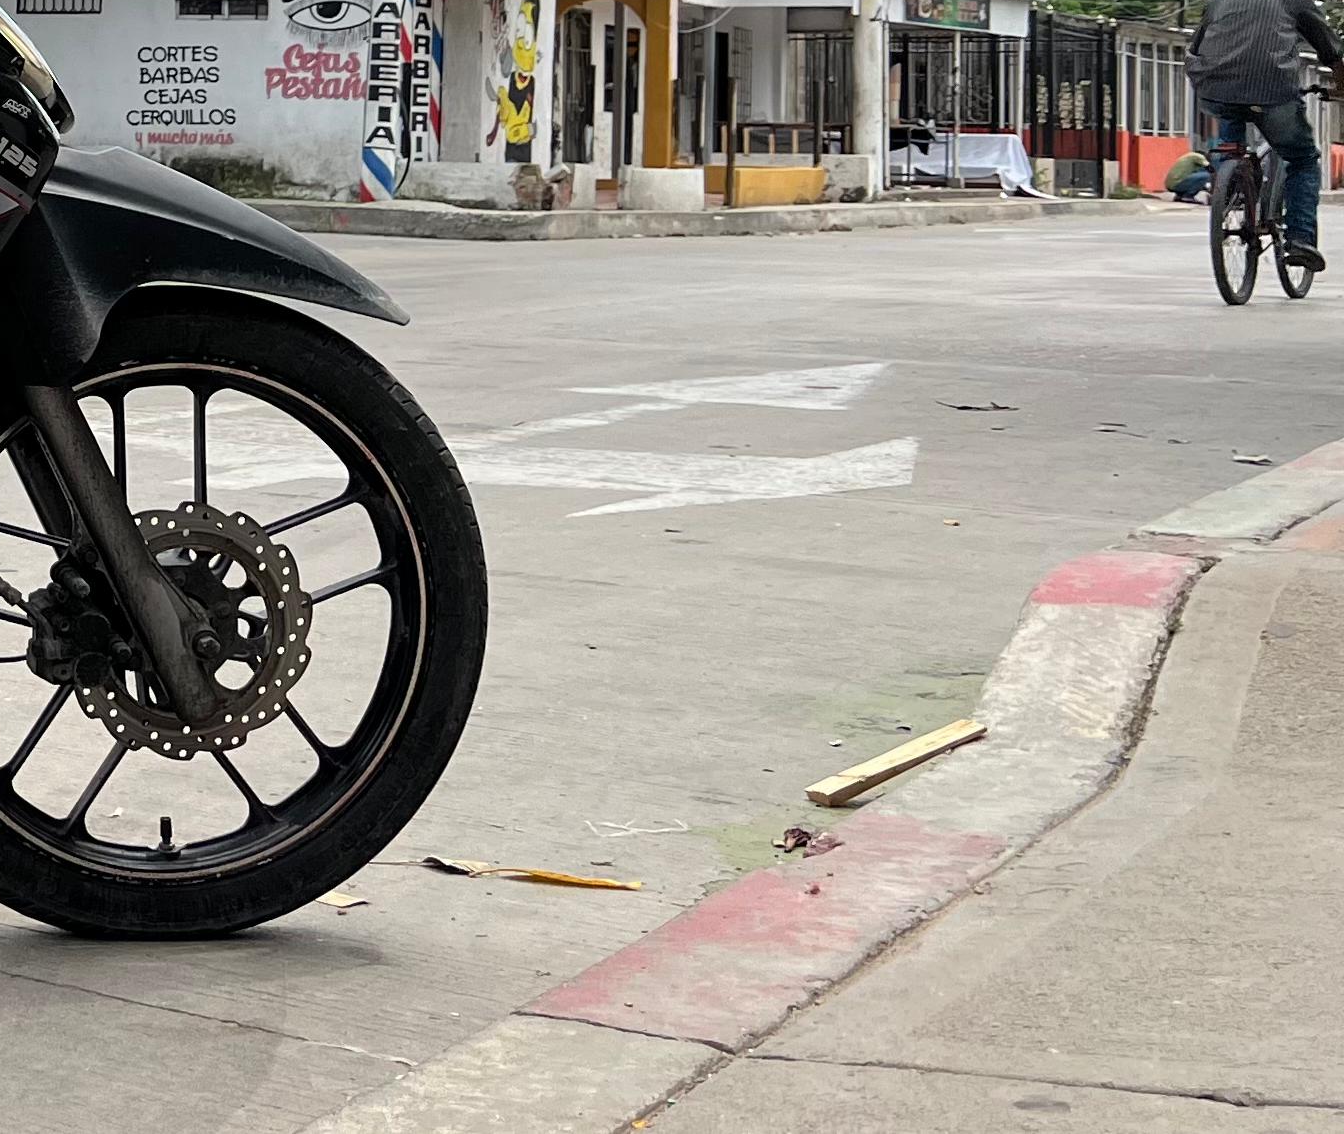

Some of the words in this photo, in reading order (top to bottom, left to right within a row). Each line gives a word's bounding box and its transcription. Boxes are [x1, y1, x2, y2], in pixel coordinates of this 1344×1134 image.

[137, 45, 219, 63] CORTES
[283, 43, 361, 80] Cejas
[139, 66, 220, 84] BARBAS
[143, 88, 207, 105] CEJAS
[126, 108, 236, 126] CERQUILLOS
[135, 130, 144, 149] y
[148, 128, 198, 145] mucho
[200, 128, 235, 146] más
